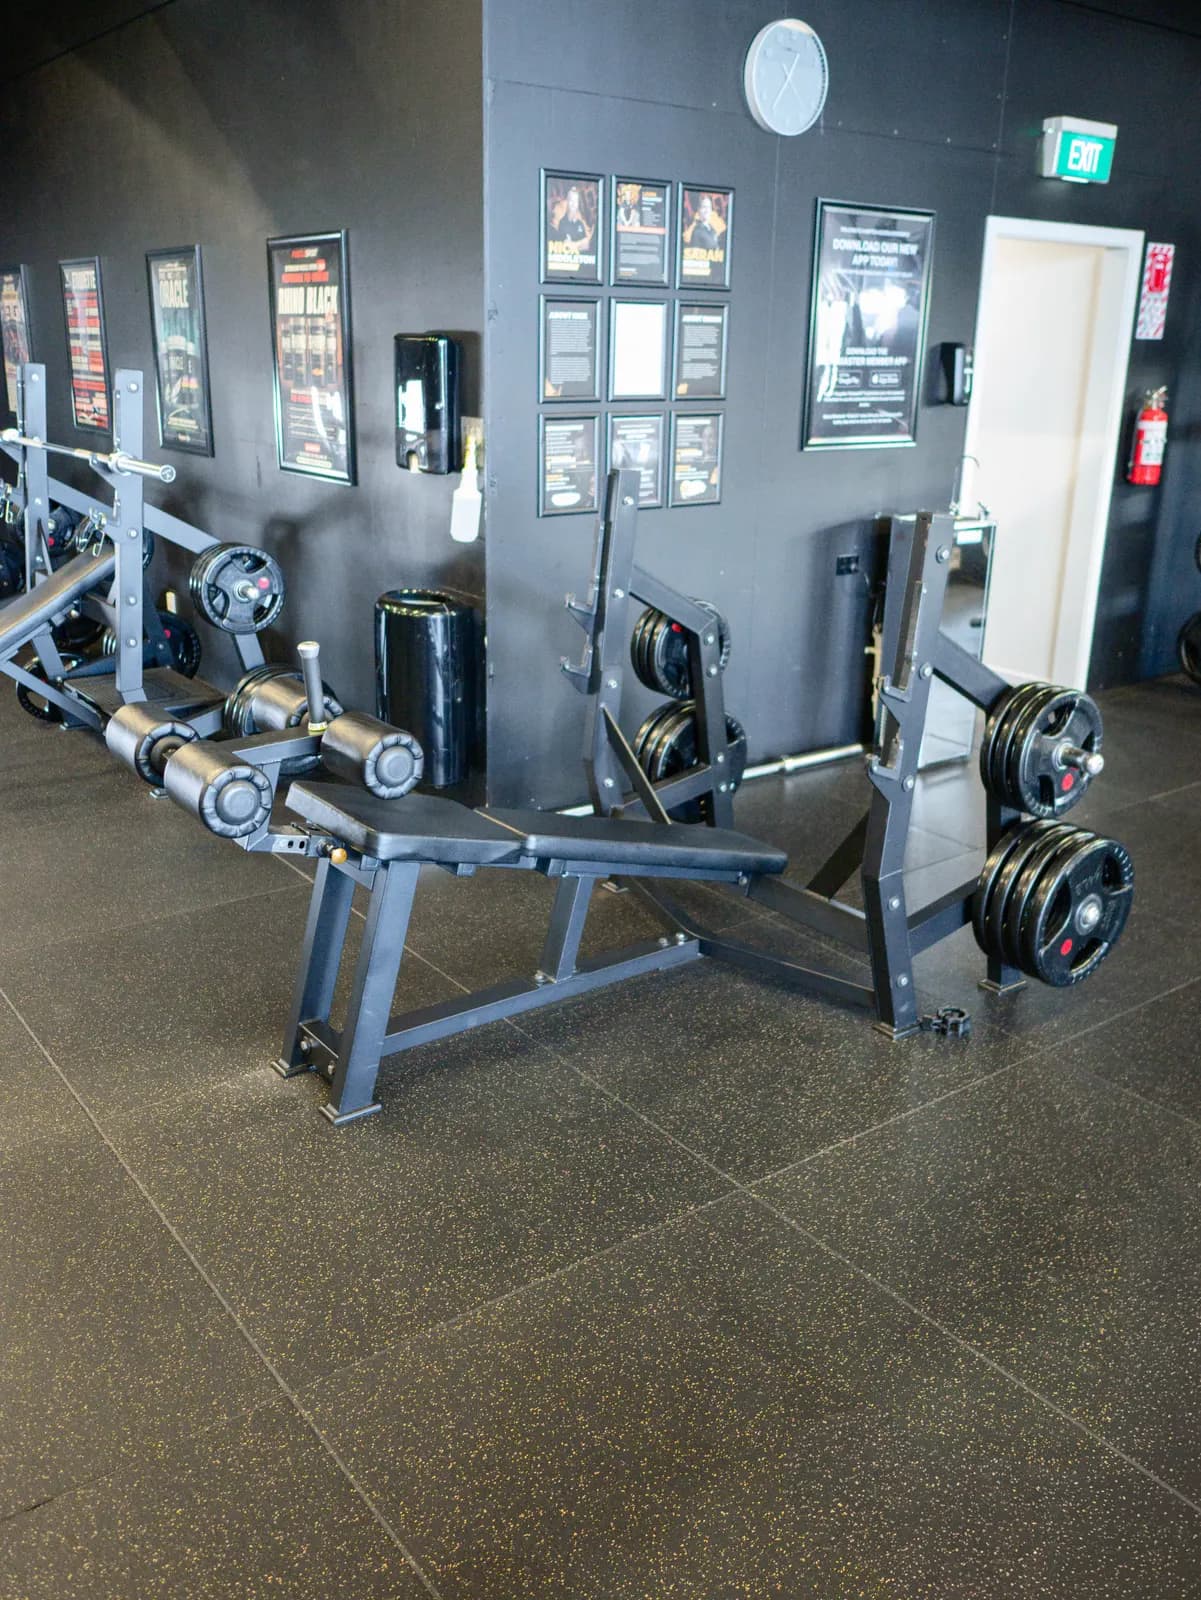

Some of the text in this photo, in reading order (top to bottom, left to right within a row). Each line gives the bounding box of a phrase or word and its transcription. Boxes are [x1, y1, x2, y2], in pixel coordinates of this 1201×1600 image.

[1068, 139, 1103, 173] EXIT
[832, 239, 919, 256] DOWNLOAD OUR NEW
[851, 253, 870, 266] APP
[306, 286, 338, 315] BLACK
[894, 356, 909, 367] APP
